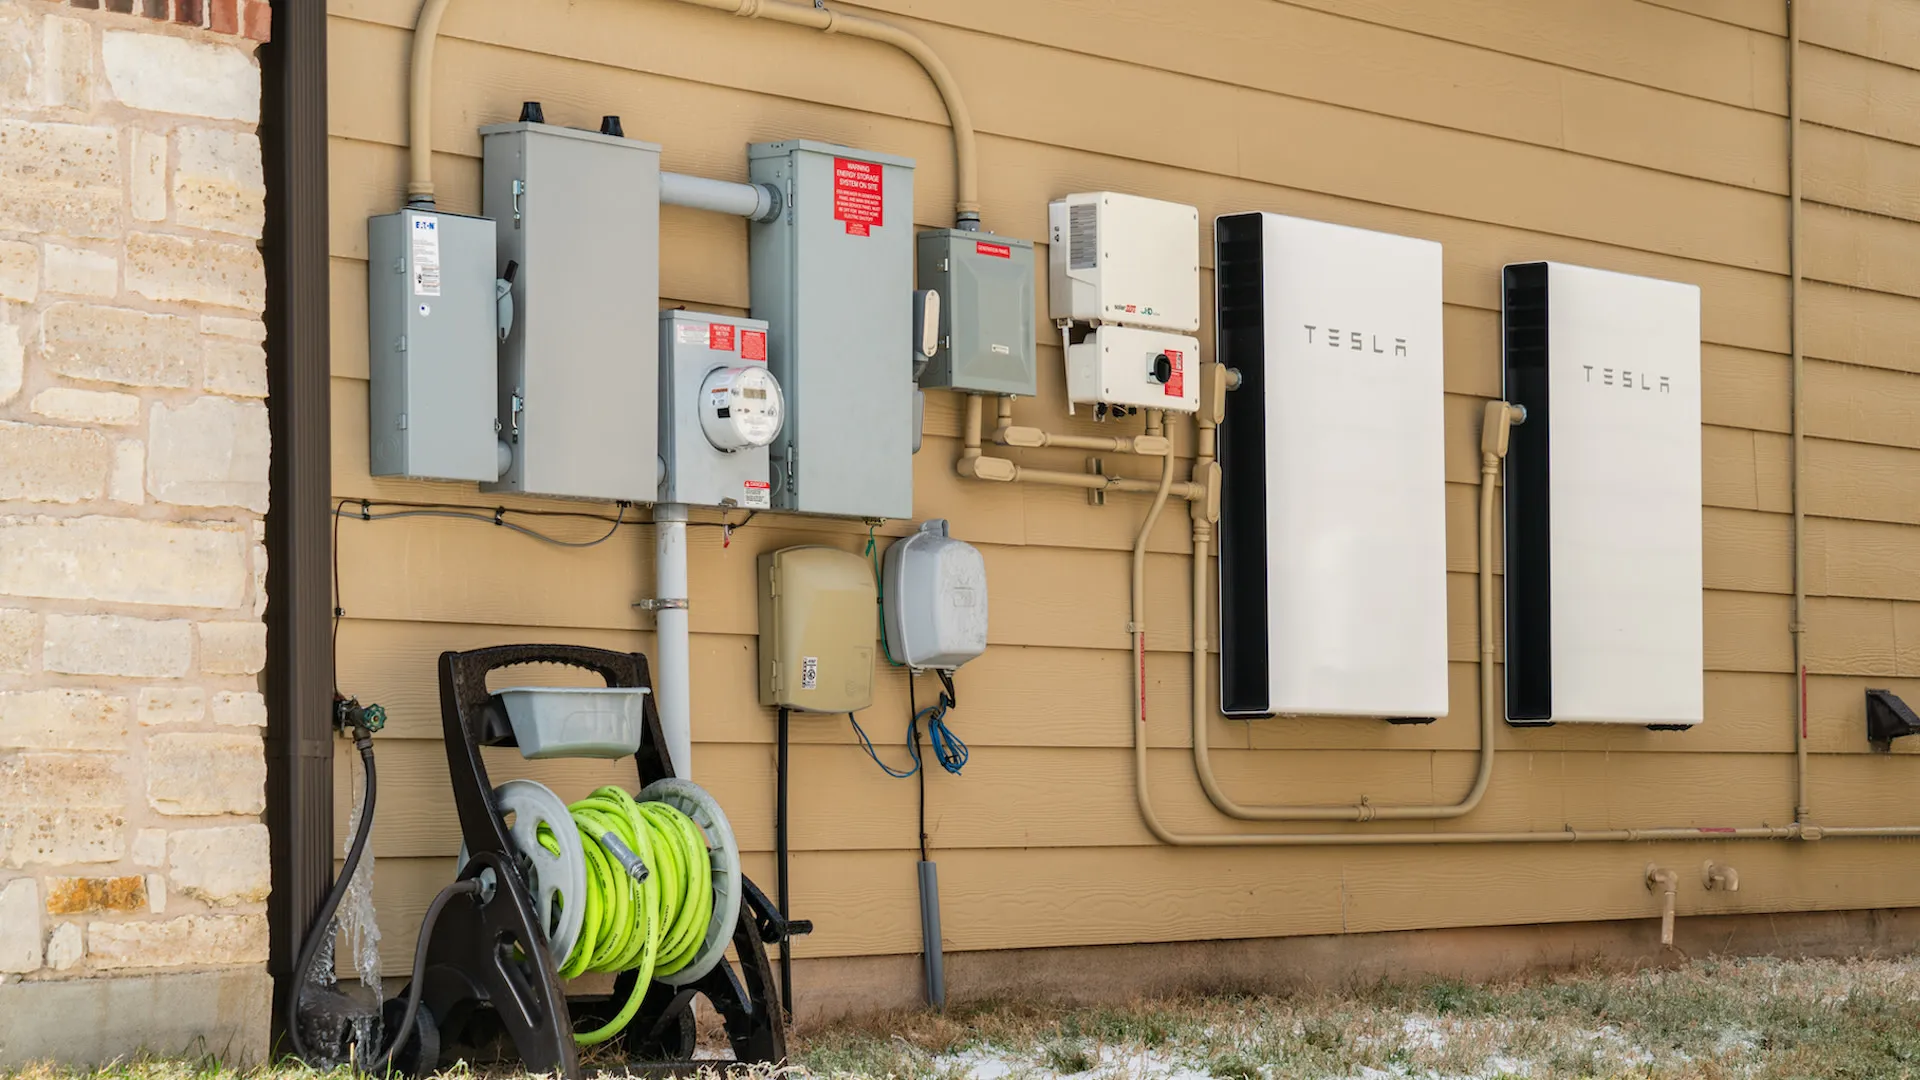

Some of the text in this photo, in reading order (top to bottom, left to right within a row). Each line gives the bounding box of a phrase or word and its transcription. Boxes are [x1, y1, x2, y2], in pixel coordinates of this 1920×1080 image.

[848, 163, 870, 172] WARNING
[837, 169, 879, 182] ENERGY STORAGE
[839, 178, 858, 187] SYSTEM
[868, 183, 878, 191] SITE
[1304, 324, 1407, 357] TESLA
[1583, 364, 1670, 394] TESLA
